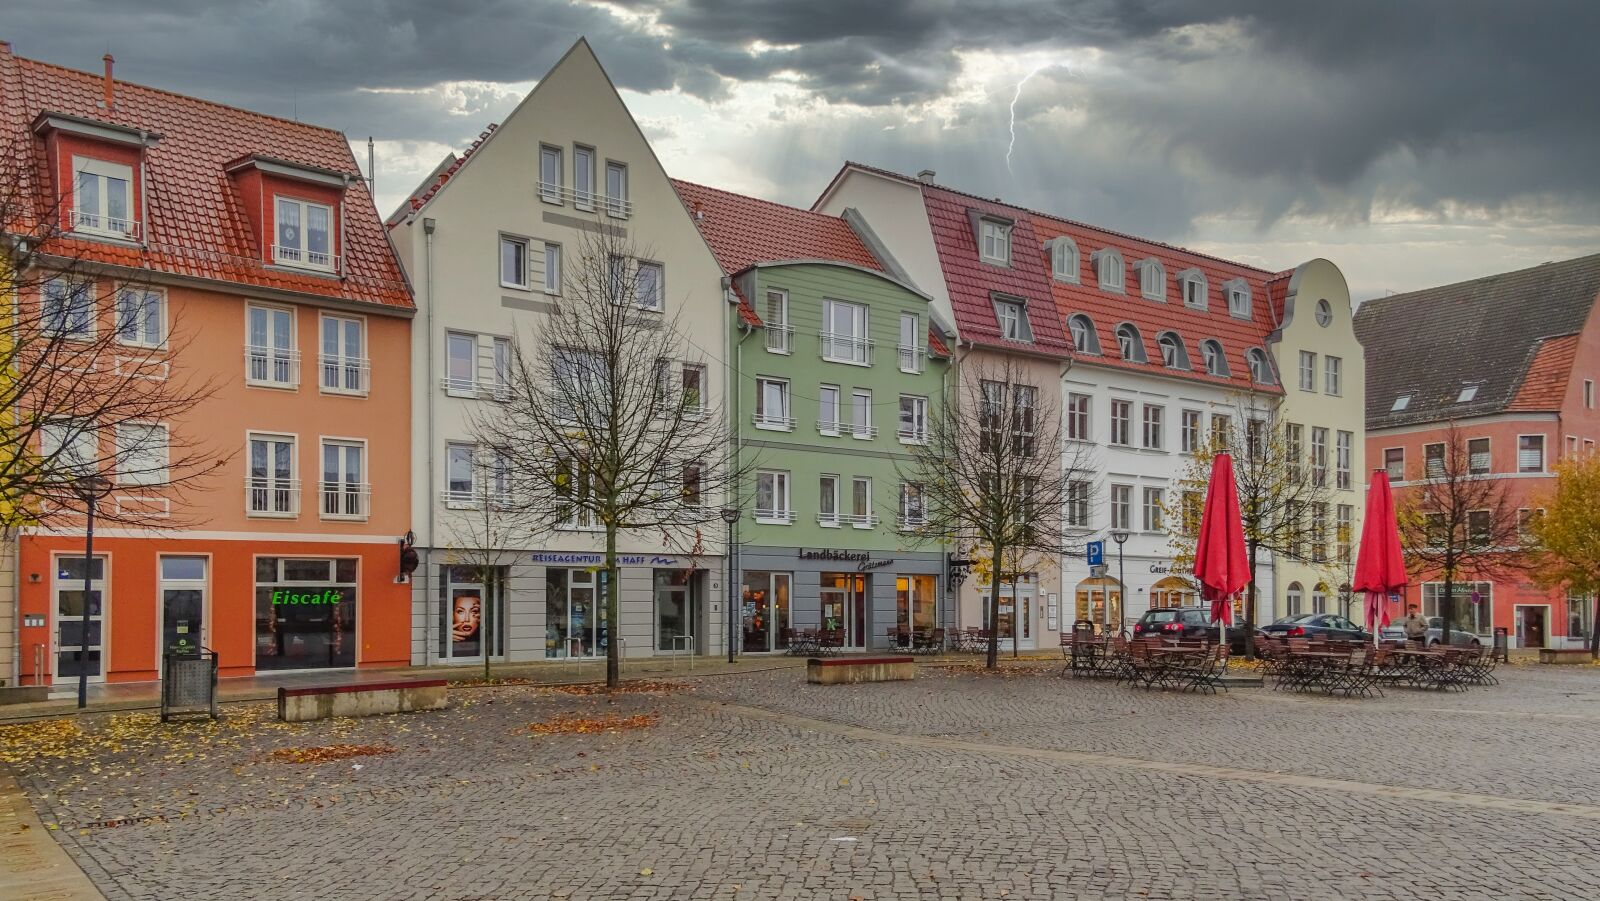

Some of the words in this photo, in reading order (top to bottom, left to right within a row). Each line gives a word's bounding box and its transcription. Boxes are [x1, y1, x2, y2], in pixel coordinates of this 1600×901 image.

[532, 554, 601, 563] REISEAGENTUR
[622, 556, 645, 565] HAFF
[799, 547, 870, 562] Landbäckerei
[1090, 544, 1099, 563] P
[272, 590, 341, 605] Eiscafé
